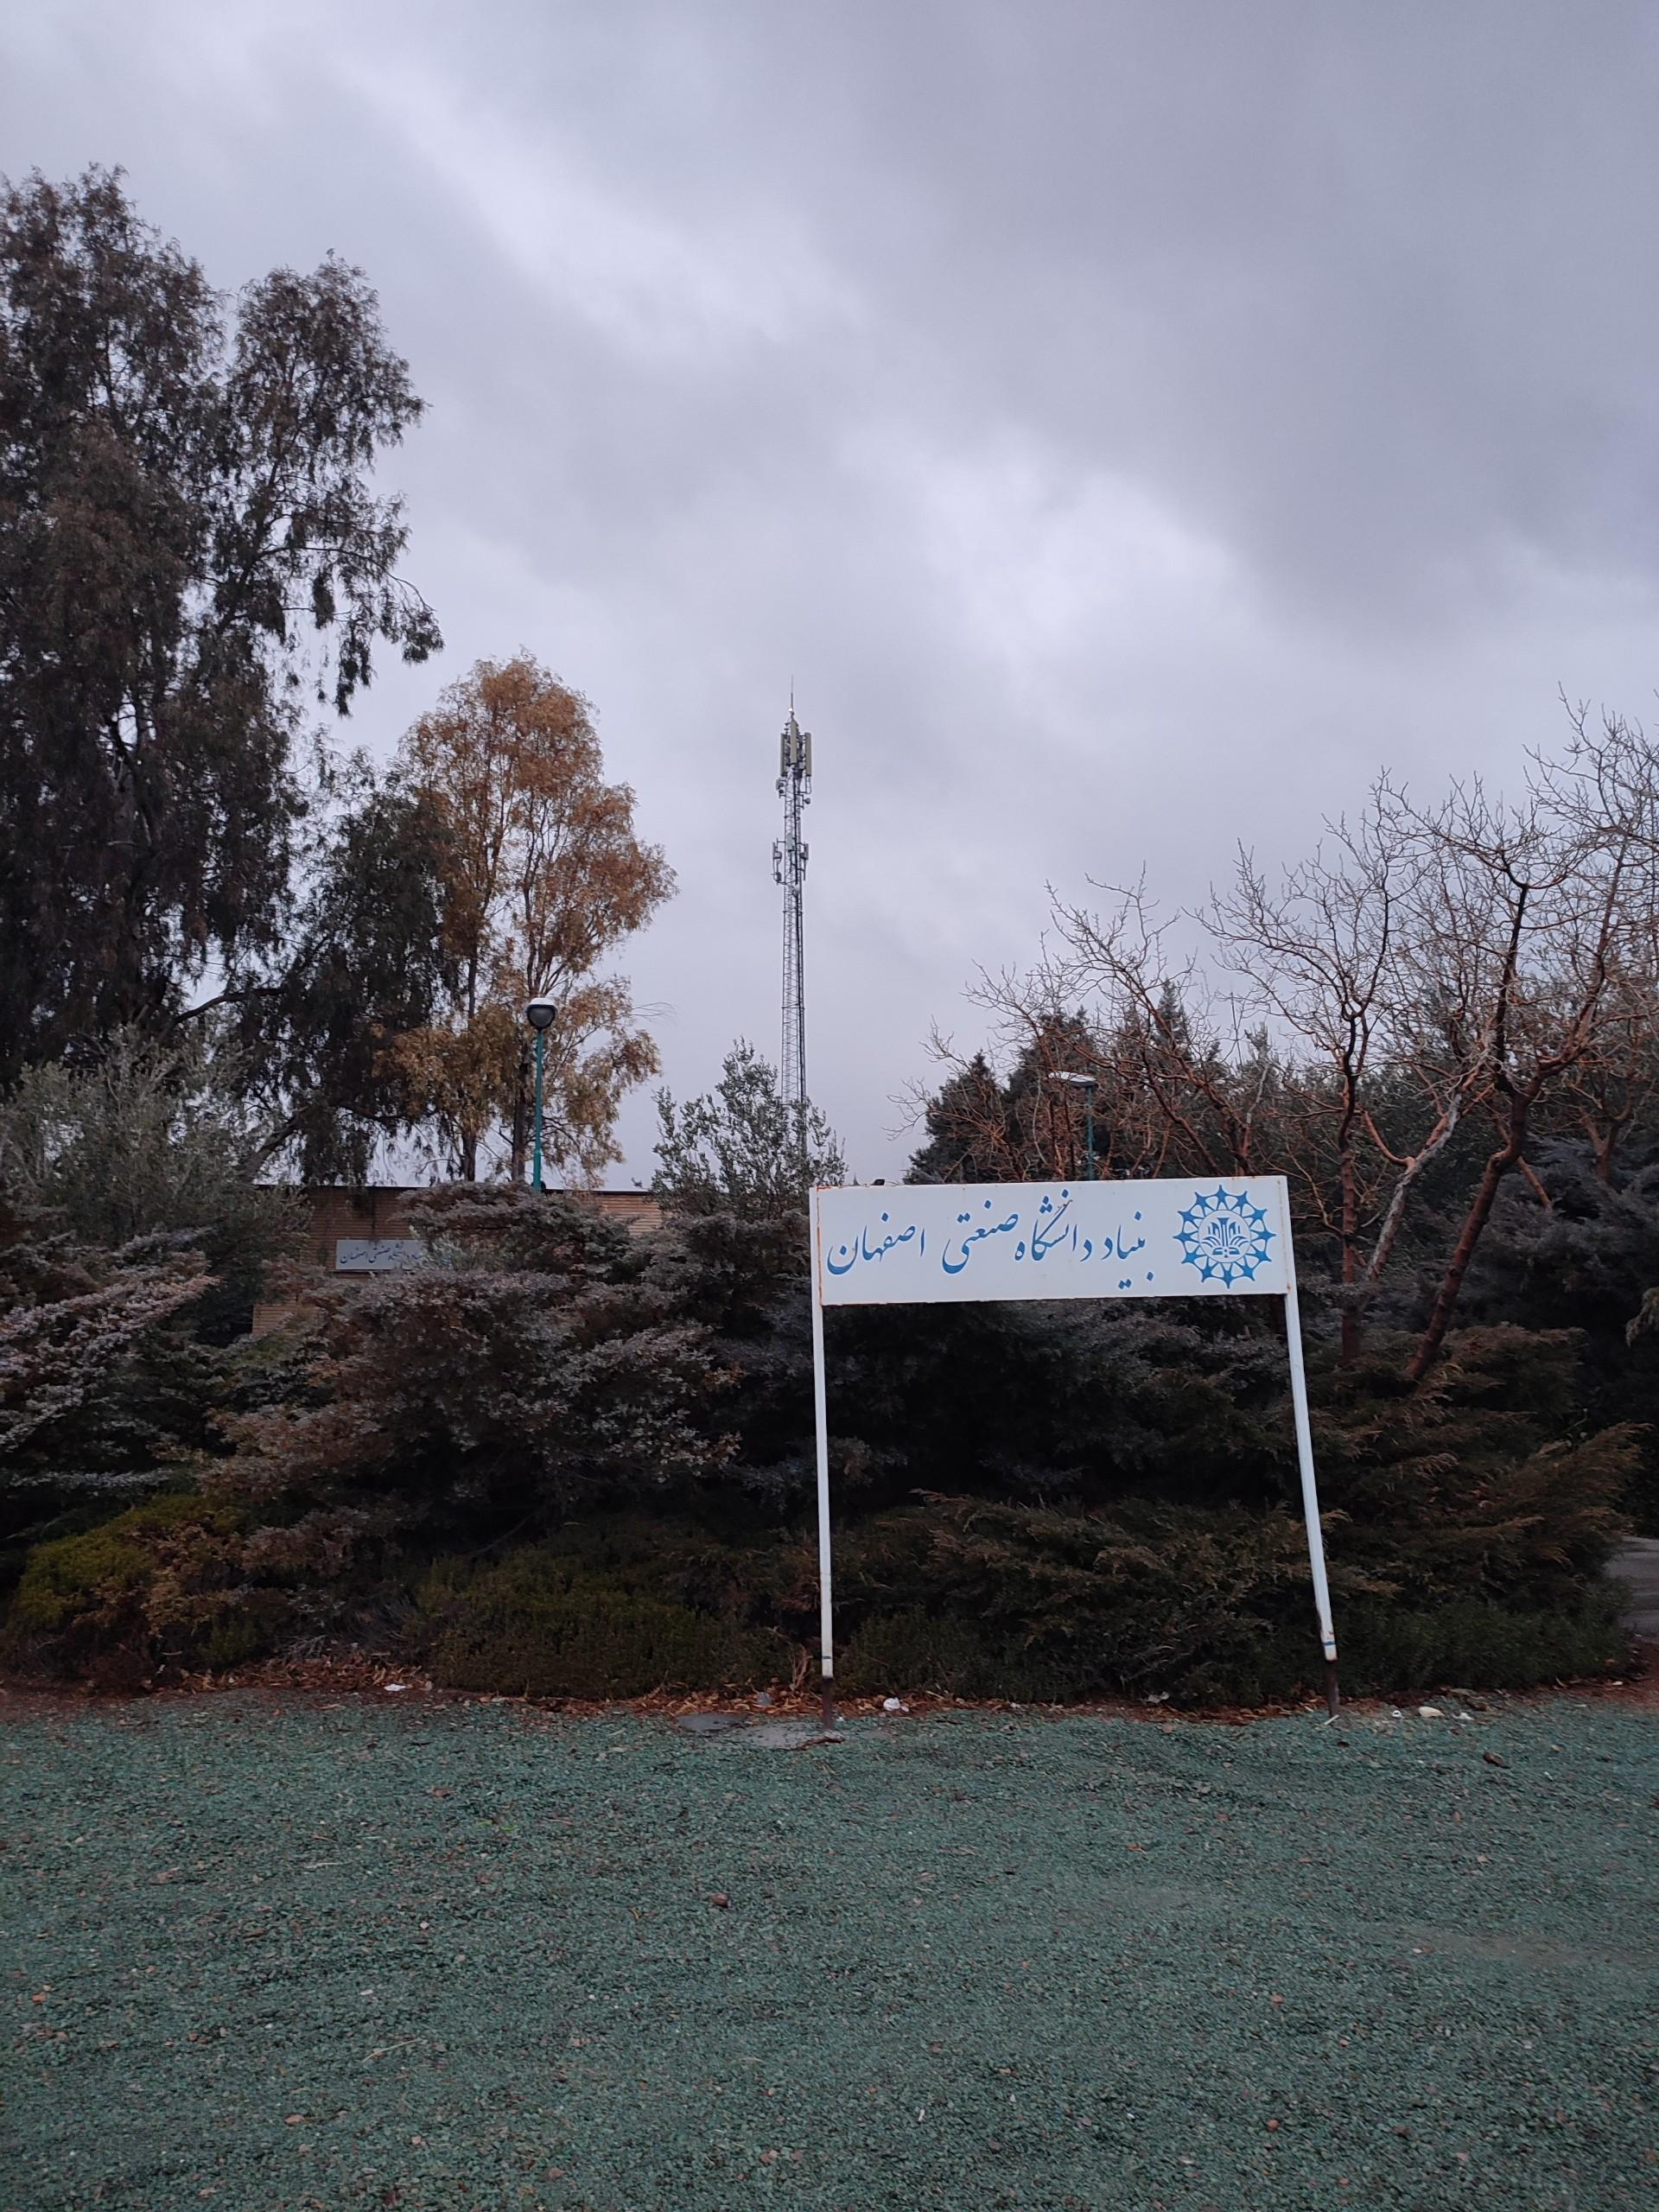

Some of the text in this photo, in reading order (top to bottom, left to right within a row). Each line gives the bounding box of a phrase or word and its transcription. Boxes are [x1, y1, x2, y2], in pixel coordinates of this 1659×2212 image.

[827, 1189, 1155, 1289] بنیاد دانشگاه صنعتی اصفهان
